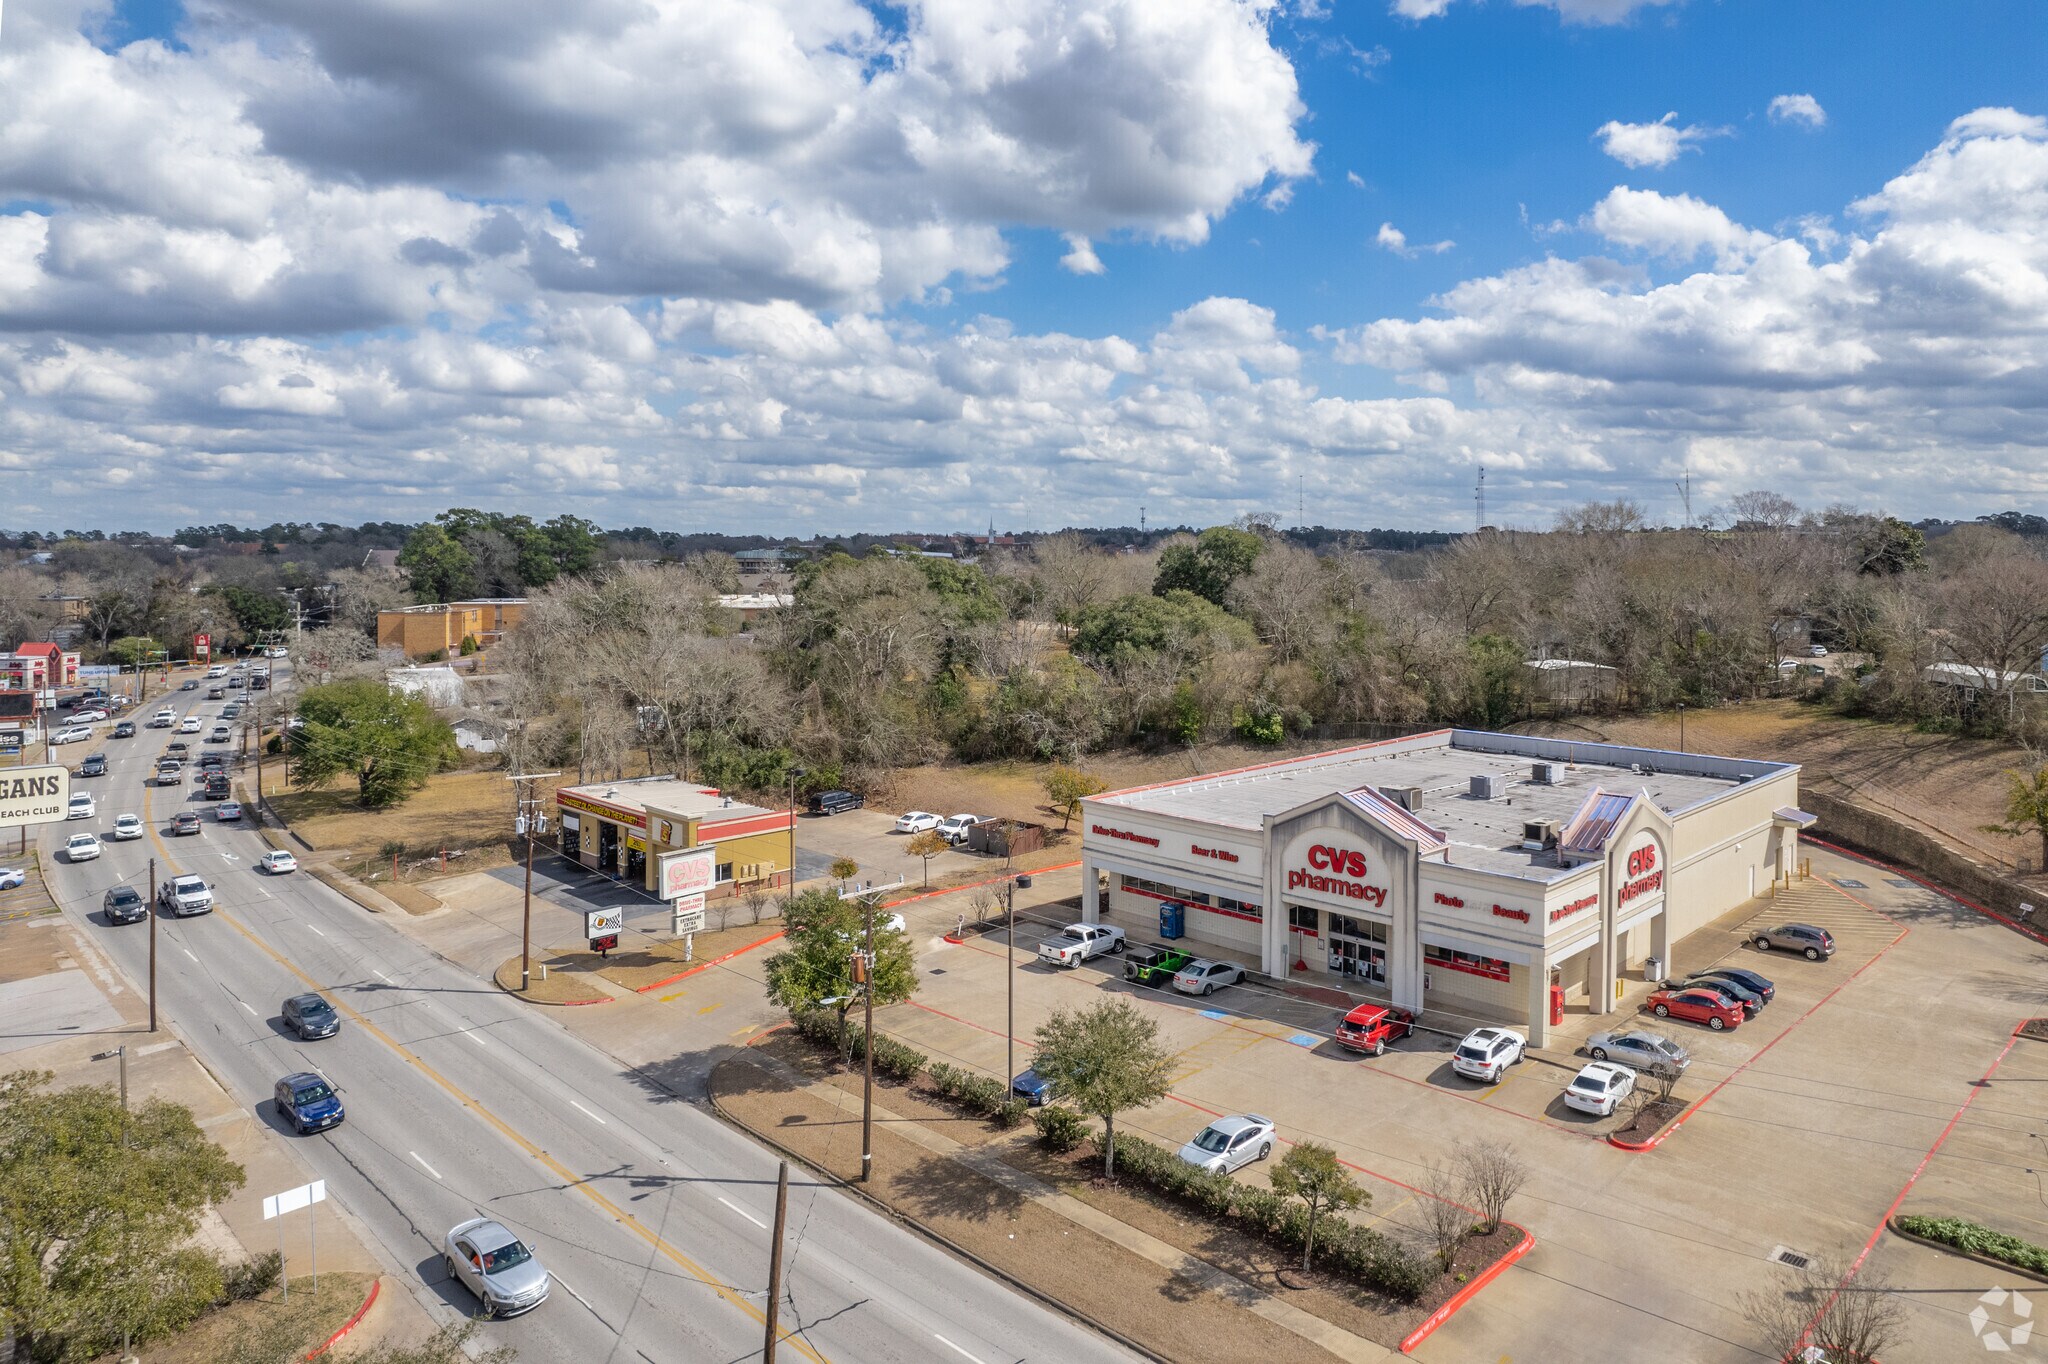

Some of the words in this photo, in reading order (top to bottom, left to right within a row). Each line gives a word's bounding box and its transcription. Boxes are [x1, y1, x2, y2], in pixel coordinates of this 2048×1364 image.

[33, 806, 60, 816] CLUB
[1125, 831, 1160, 848] Pharmacy
[1191, 844, 1210, 857] Beer
[1218, 850, 1239, 862] Wine
[1308, 844, 1367, 878] CVS
[1628, 844, 1656, 878] CVS
[668, 857, 710, 883] CVS
[669, 878, 708, 894] pharmacy
[1288, 868, 1388, 908] pharmacy
[1618, 870, 1663, 908] pharmacy
[678, 897, 704, 906] DRIVE-THRU
[680, 902, 702, 912] PHARMACY
[1434, 892, 1464, 908] Photo
[1492, 904, 1530, 924] Beauty
